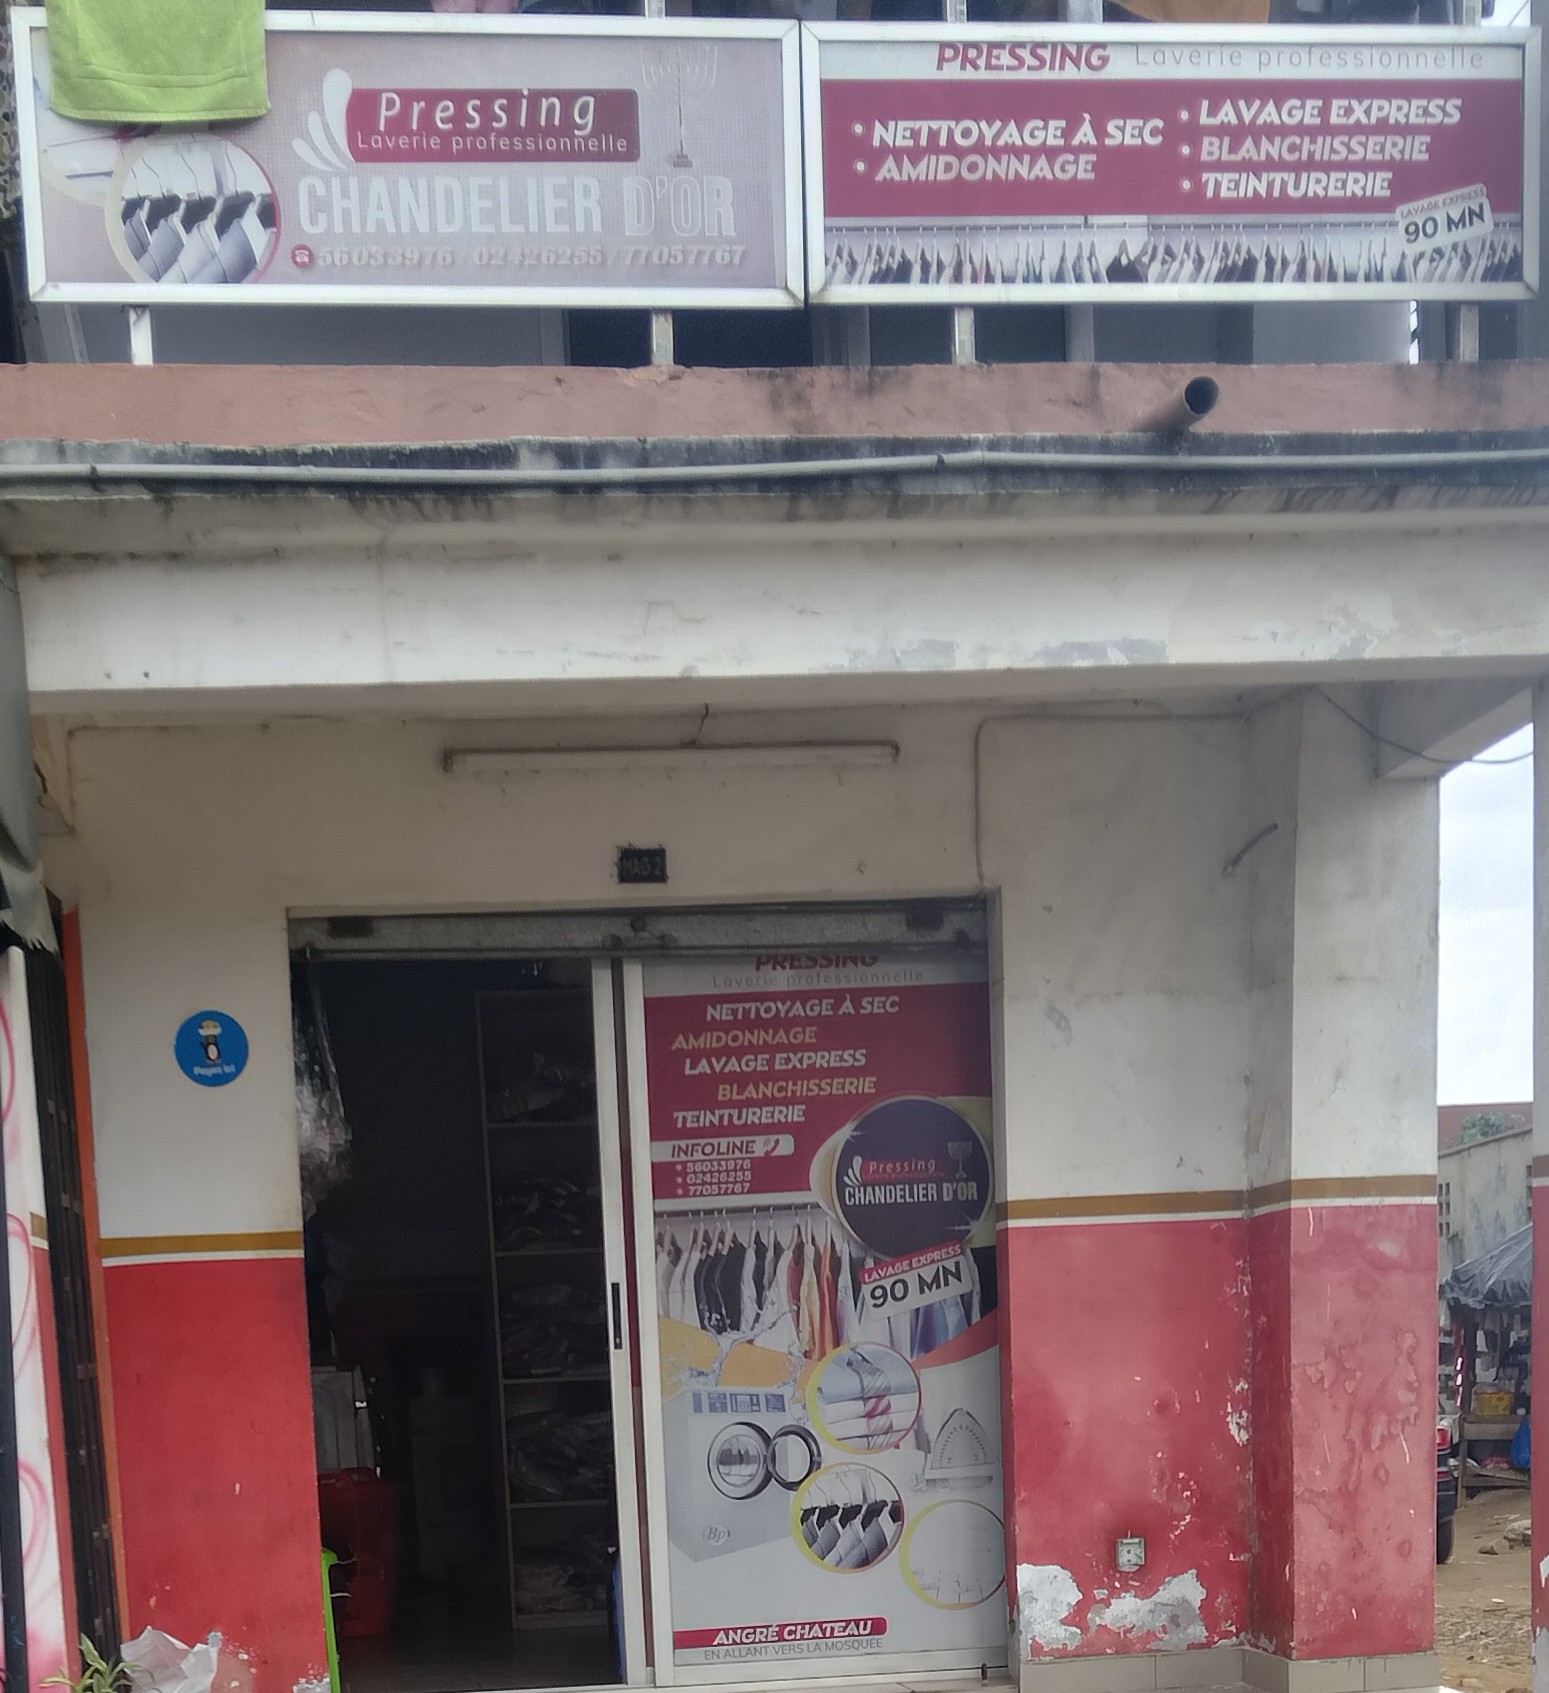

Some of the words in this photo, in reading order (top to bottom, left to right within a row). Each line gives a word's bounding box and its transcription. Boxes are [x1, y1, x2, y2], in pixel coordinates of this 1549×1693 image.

[936, 42, 1111, 71] PRESSING
[1135, 45, 1242, 66] Laverie
[1258, 45, 1483, 72] professionnelle
[378, 88, 597, 136] Pressing
[1200, 98, 1322, 126] LAVAGE
[1329, 97, 1462, 125] EXPRESS
[357, 131, 441, 150] Laverie
[452, 131, 628, 154] professionnelle
[873, 118, 1066, 147] NETTOYAGE
[1071, 112, 1098, 146] À
[1104, 118, 1164, 146] SEC
[1200, 134, 1431, 162] BLANCHISSERIE
[875, 153, 1098, 183] AMIDONNAGE
[1202, 171, 1393, 199] TEINTURERIE
[299, 175, 602, 235] CHANDELIER
[623, 176, 736, 237] D'OR
[1401, 200, 1440, 219] LAVAGE
[1442, 187, 1485, 207] EXPRESS
[1404, 216, 1439, 243] 90
[1446, 202, 1485, 233] MN
[317, 247, 453, 266] 56033976
[624, 245, 746, 266] 77057767
[755, 953, 880, 971] PRESSING
[713, 975, 778, 988] Laverie
[787, 970, 924, 987] professionnelle
[706, 998, 833, 1021] NETTOYAGE
[838, 994, 855, 1015] À
[860, 996, 899, 1014] SEC
[671, 1026, 817, 1051] AMIDONNAGE
[684, 1053, 769, 1076] LAVAGE
[774, 1049, 866, 1071] EXPRESS
[718, 1076, 877, 1101] BLANCHISSERIE
[673, 1104, 806, 1129] TEINTURERIE
[671, 1140, 756, 1159] INFOLINE
[686, 1159, 752, 1173] 56033976
[686, 1171, 752, 1184] 02426255
[869, 1159, 936, 1175] Pressing
[688, 1183, 751, 1196] 77057767
[845, 1183, 938, 1206] CHANDELIER
[942, 1181, 978, 1201] D'OR
[864, 1260, 910, 1282] LAVAGE
[912, 1244, 961, 1269] EXPRESS
[870, 1278, 909, 1308] 90
[918, 1261, 962, 1295] MN
[713, 1624, 780, 1646] ANGRÉ
[783, 1620, 872, 1640] CHATEAU
[704, 1650, 722, 1661] EN
[723, 1646, 770, 1660] ALLANT
[772, 1644, 804, 1656] VERS
[806, 1642, 822, 1653] LA
[825, 1638, 883, 1652] MOSQUÉE
